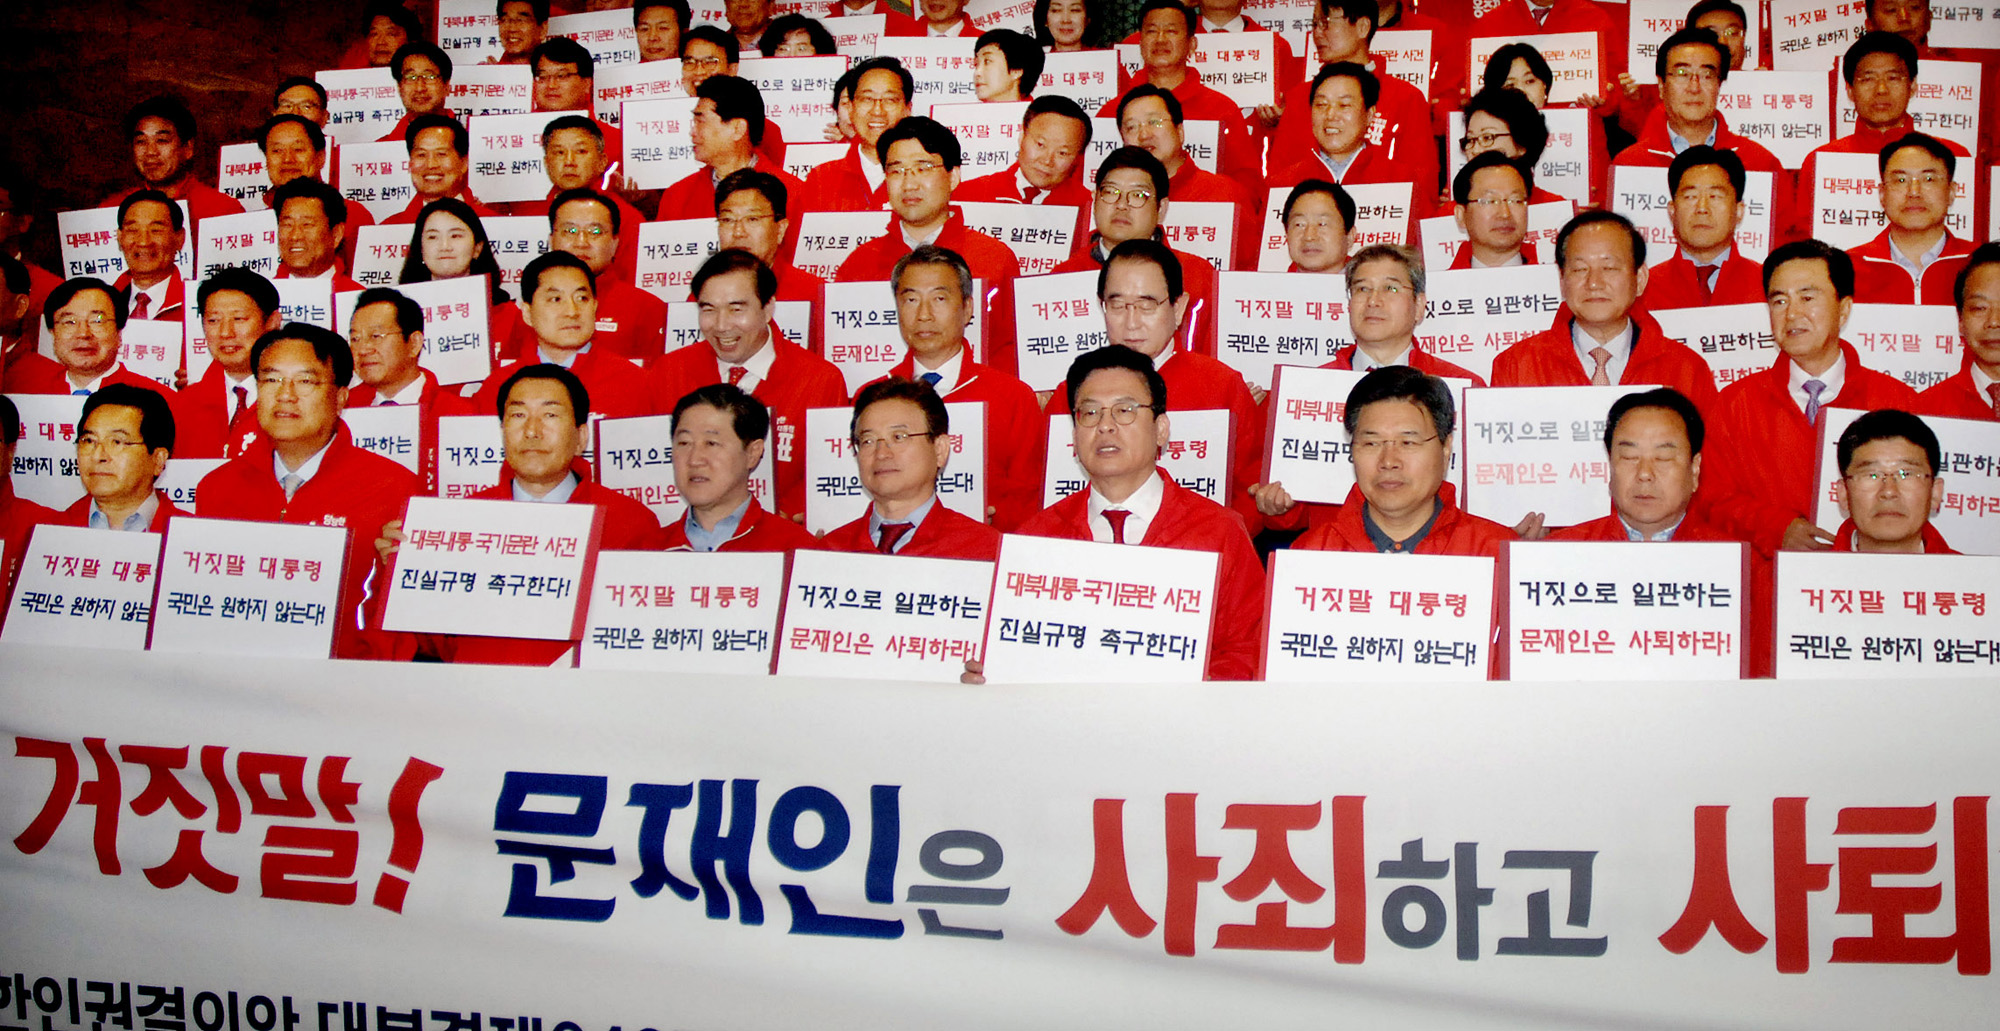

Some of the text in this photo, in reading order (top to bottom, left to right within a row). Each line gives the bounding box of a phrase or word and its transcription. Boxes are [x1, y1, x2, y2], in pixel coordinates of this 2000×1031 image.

[443, 15, 475, 27] 대북내통
[1783, 9, 1829, 27] 거짓말
[1931, 6, 1984, 22] 진실규명
[442, 36, 482, 50] 진실규명
[1780, 30, 1850, 54] 국민은 원하지
[1217, 48, 1260, 62] 대통령
[1402, 47, 1425, 62] 사건
[1569, 47, 1593, 62] 사건
[1063, 71, 1104, 85] 대통령
[1231, 70, 1266, 86] 않는다!
[508, 84, 527, 97] 사건
[598, 87, 634, 100] 대북내통
[1949, 85, 1973, 101] 사건
[1720, 92, 1813, 110] 짓말 대통령
[637, 120, 680, 134] 거짓말
[1739, 122, 1822, 141] 원하지 않는다!
[482, 135, 524, 149] 거짓말
[630, 146, 663, 161] 국민은
[976, 149, 1009, 166] 원하지
[352, 163, 391, 176] 거짓말
[476, 157, 541, 175] 국민은 원하지
[1541, 161, 1583, 178] 않는다!
[346, 184, 411, 202] 국민은 원하지
[1822, 177, 1878, 196] 대북내통
[1822, 208, 1886, 226] 진실규명
[66, 231, 112, 247] 대북내통
[211, 234, 253, 253] 거짓말
[803, 234, 849, 252] 거짓으로
[1009, 229, 1068, 252] 일관하는
[1165, 225, 1217, 243] 대통령
[643, 242, 699, 260] 거짓으로
[359, 271, 392, 285] 국민은
[1032, 299, 1089, 320] 거짓말
[1236, 299, 1350, 320] 거짓말 대통
[1485, 293, 1560, 316] 일관하는
[832, 310, 898, 330] 거짓으로
[438, 333, 481, 353] 않는다!
[1027, 335, 1069, 357] 국민은
[1226, 334, 1270, 354] 국민은
[1277, 334, 1319, 356] 원하지
[1419, 334, 1475, 355] 재인은
[1701, 331, 1774, 353] 일관하는
[1857, 332, 1922, 354] 거짓말
[831, 344, 896, 363] 문재인은
[1286, 398, 1346, 423] 대북내통
[39, 422, 76, 441] 대통
[1474, 420, 1609, 445] 거짓으로 일관
[13, 456, 53, 476] 원하지
[1475, 462, 1608, 487] 문재인은 사퇴
[816, 472, 974, 496] 국민은 는다!
[544, 536, 578, 558] 사건
[42, 554, 153, 584] 거짓말 대통
[183, 550, 322, 583] 거짓말 대통령
[400, 568, 572, 599] 진실규명 촉구한다!
[605, 584, 760, 609] 거짓말 대통령
[797, 584, 983, 620] 거짓으로 일관하는
[1162, 587, 1202, 614] 사건
[1294, 586, 1468, 618] 거짓말 대통령
[1519, 581, 1732, 609] 거짓으로 일관하는
[1800, 588, 1986, 617] 거짓말 대통령
[20, 591, 151, 626] 국민은 원하지 않는
[167, 591, 326, 627] 국민은 원하지 않는다!
[591, 626, 769, 653] 국민은 원하지 않는다!
[789, 627, 977, 663] 문재인은 사퇴하라!
[999, 617, 1198, 662] 진실규명 촉구한다!
[1519, 628, 1732, 657] 문재인은 사퇴하라!
[1280, 632, 1477, 668] 국민은 원하지 않는다!
[1789, 634, 2000, 666] 국민은 원하지 않는다!
[13, 736, 1991, 977] 거짓말! 문재인은 사죄하고 사퇴
